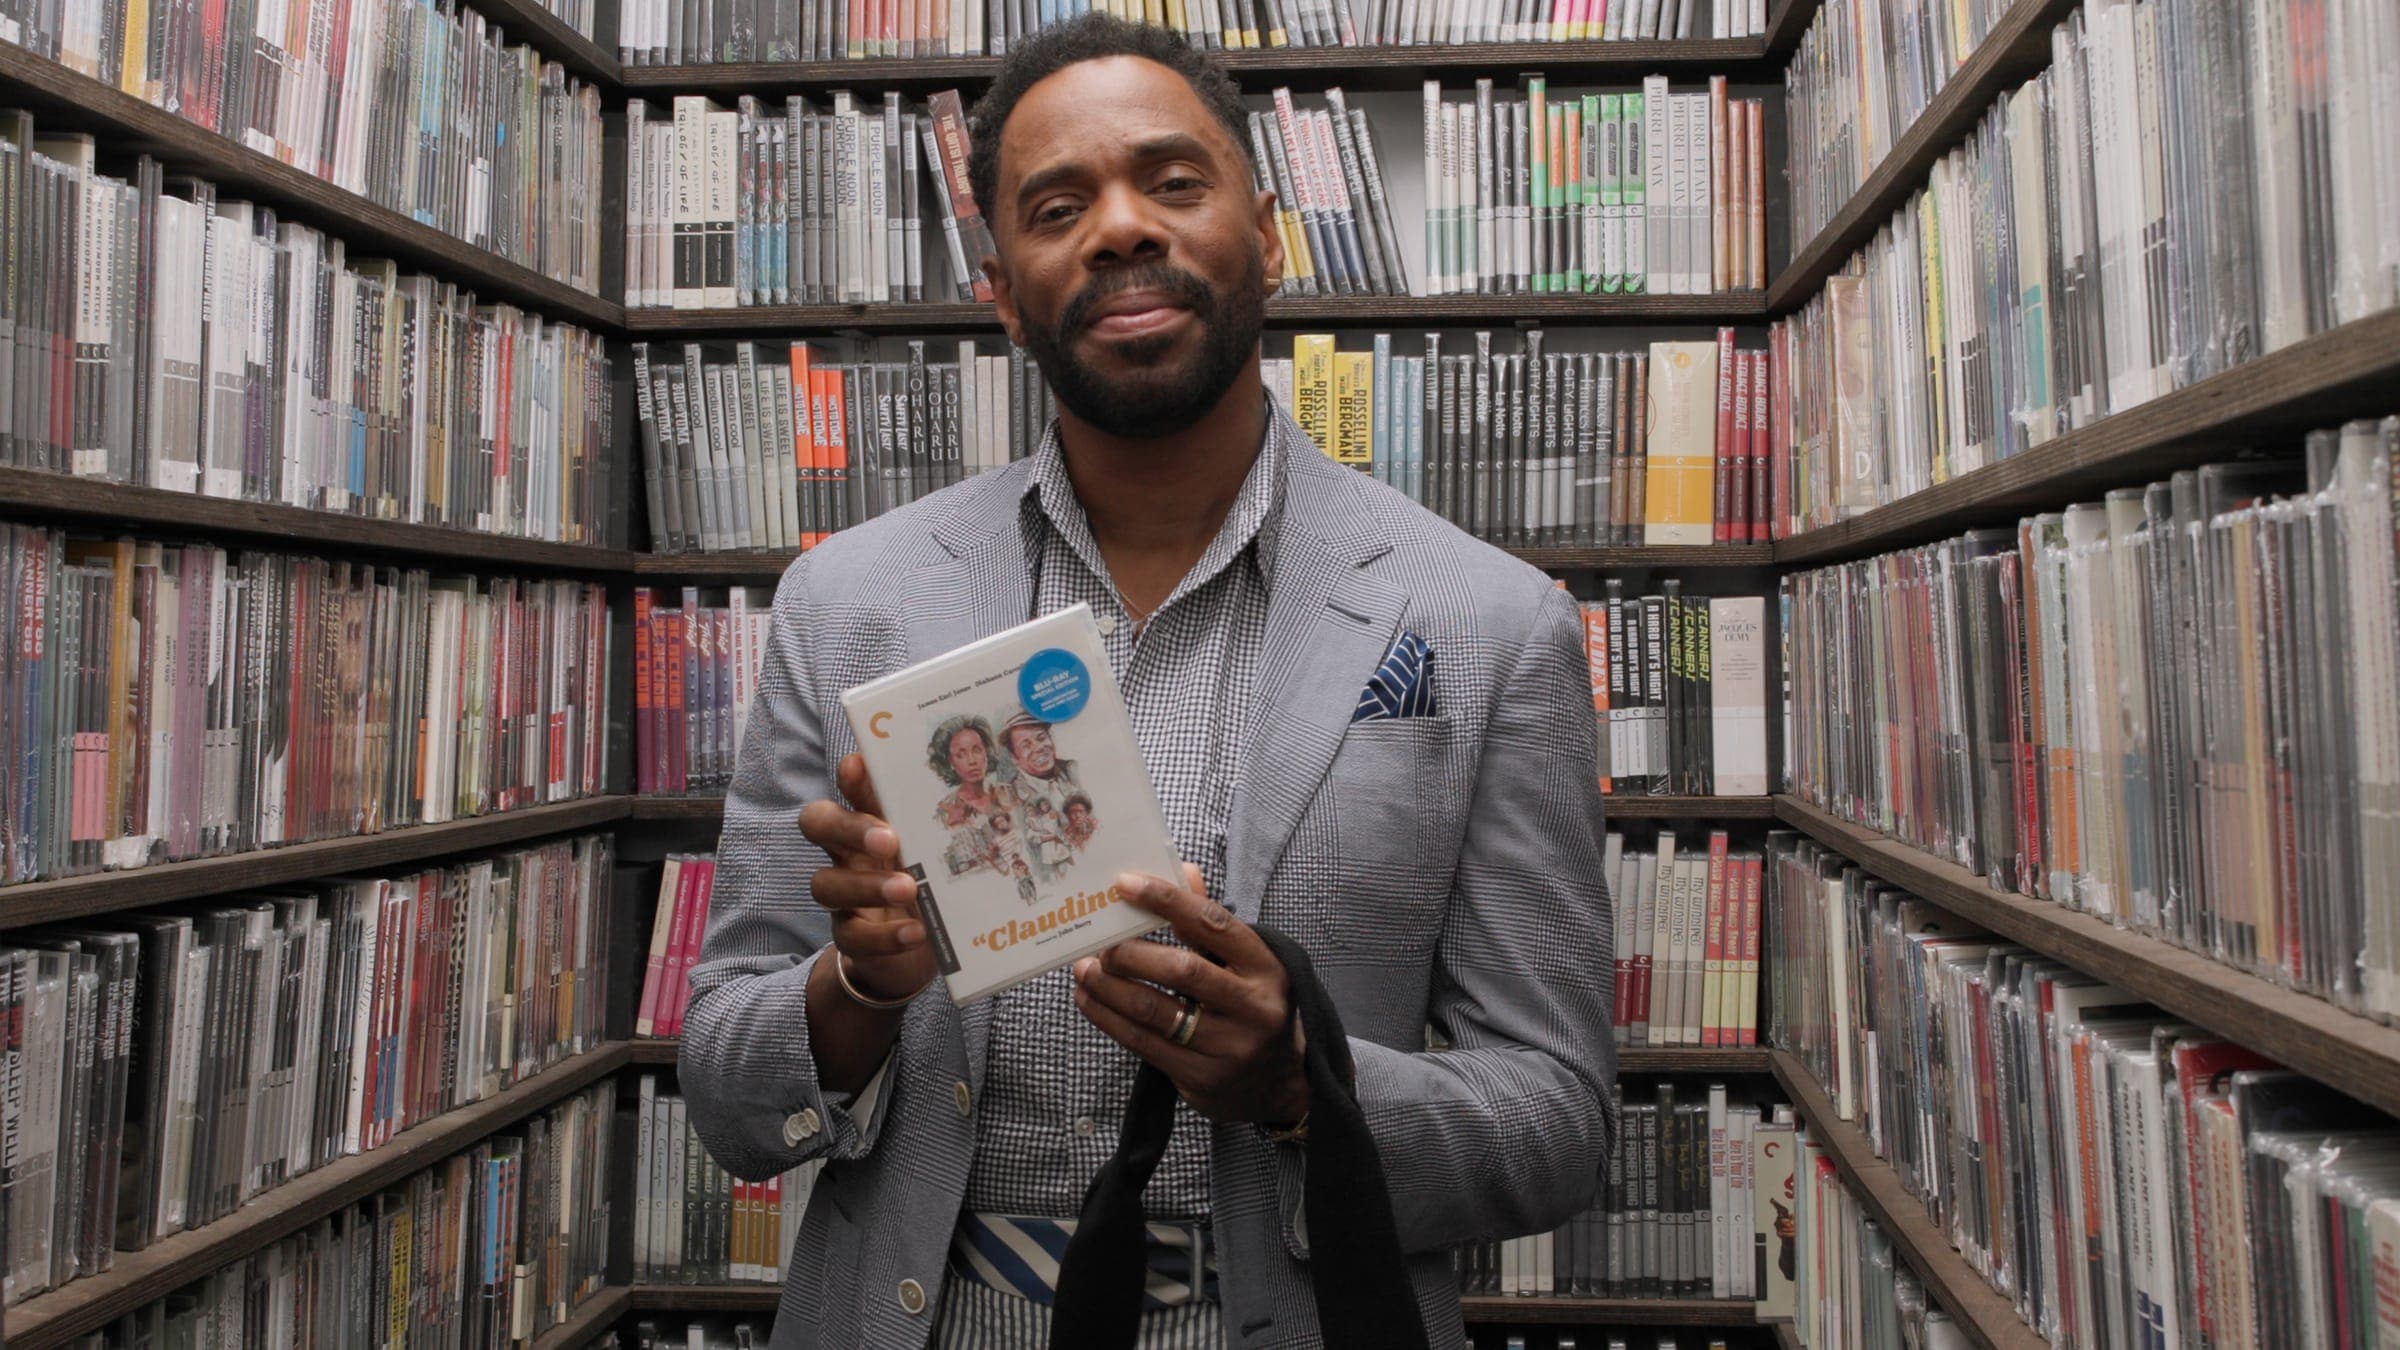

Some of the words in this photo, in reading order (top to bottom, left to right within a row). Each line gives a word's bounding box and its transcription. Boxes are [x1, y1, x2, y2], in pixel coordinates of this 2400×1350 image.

[1651, 86, 1662, 135] PIERRE
[1673, 101, 1685, 150] PIERRE
[1694, 101, 1706, 150] PIERRE
[845, 116, 856, 167] PURPLE
[871, 127, 880, 176] PURPLE
[941, 114, 955, 132] THE
[952, 159, 971, 194] TRILOGY
[680, 185, 688, 214] LIFE
[711, 188, 720, 212] LIFE
[847, 173, 856, 206] NOON
[873, 182, 882, 216] NOON
[687, 355, 700, 401] medium
[739, 352, 749, 375] LIFE
[1477, 373, 1487, 387] La
[1530, 360, 1540, 389] CITY
[1736, 360, 1747, 395] TOUKI
[1756, 360, 1766, 395] TOUKI
[726, 375, 737, 421] medium
[741, 378, 752, 389] IS
[759, 380, 770, 402] LIFE
[775, 378, 787, 399] LIFE
[1495, 391, 1506, 405] La
[1512, 390, 1523, 404] La
[1546, 370, 1556, 399] CITY
[1564, 368, 1574, 399] CITY
[637, 387, 652, 421] YUMA
[692, 403, 703, 428] cool
[707, 378, 721, 424] medium
[743, 394, 755, 430] SWEET
[762, 407, 771, 417] IS
[778, 404, 788, 414] IS
[1300, 388, 1312, 436] BERGM
[1314, 380, 1327, 449] ROSSELLINI
[1530, 394, 1540, 438] LIGHTS
[1735, 397, 1747, 431] BOUKI
[1755, 397, 1766, 431] BOUKI
[657, 408, 672, 442] YUMA
[676, 410, 689, 446] YUMA
[713, 426, 723, 451] cool
[730, 423, 740, 447] cool
[780, 420, 791, 456] SWEET
[1339, 397, 1352, 457] BERGMAN
[1354, 389, 1367, 458] ROSSELLINI
[1495, 408, 1506, 439] Notte
[1512, 406, 1523, 437] Notte
[1545, 405, 1556, 448] LIGHTS
[1563, 403, 1574, 447] LIGHTS
[762, 423, 774, 459] SWEET
[24, 549, 34, 618] TANNER
[35, 550, 45, 620] TANNER
[1609, 606, 1621, 633] HARD
[1648, 613, 1660, 639] HARD
[1669, 596, 1681, 677] SCANNERS
[1610, 634, 1622, 662] DAY'S
[1627, 626, 1638, 648] HARD
[1684, 606, 1696, 682] SCANNERS
[1698, 606, 1709, 682] SCANNERS
[1590, 620, 1606, 699] JUDEX
[1648, 642, 1661, 669] DAY'S
[1033, 670, 1070, 692] BLU-RAY
[1611, 664, 1624, 693] NIGHT
[1630, 673, 1640, 696] NIGHT
[1648, 671, 1661, 701] NIGHT
[8, 1053, 22, 1107] SLEEP
[5, 1114, 20, 1166] WELL
[1625, 1118, 1636, 1137] THE
[1644, 1116, 1655, 1137] THE
[1626, 1140, 1637, 1178] FISHER
[1644, 1139, 1656, 1177] FISHER
[688, 1159, 696, 1194] HIMSELF
[1627, 1181, 1638, 1206] KING
[1645, 1179, 1656, 1205] KING
